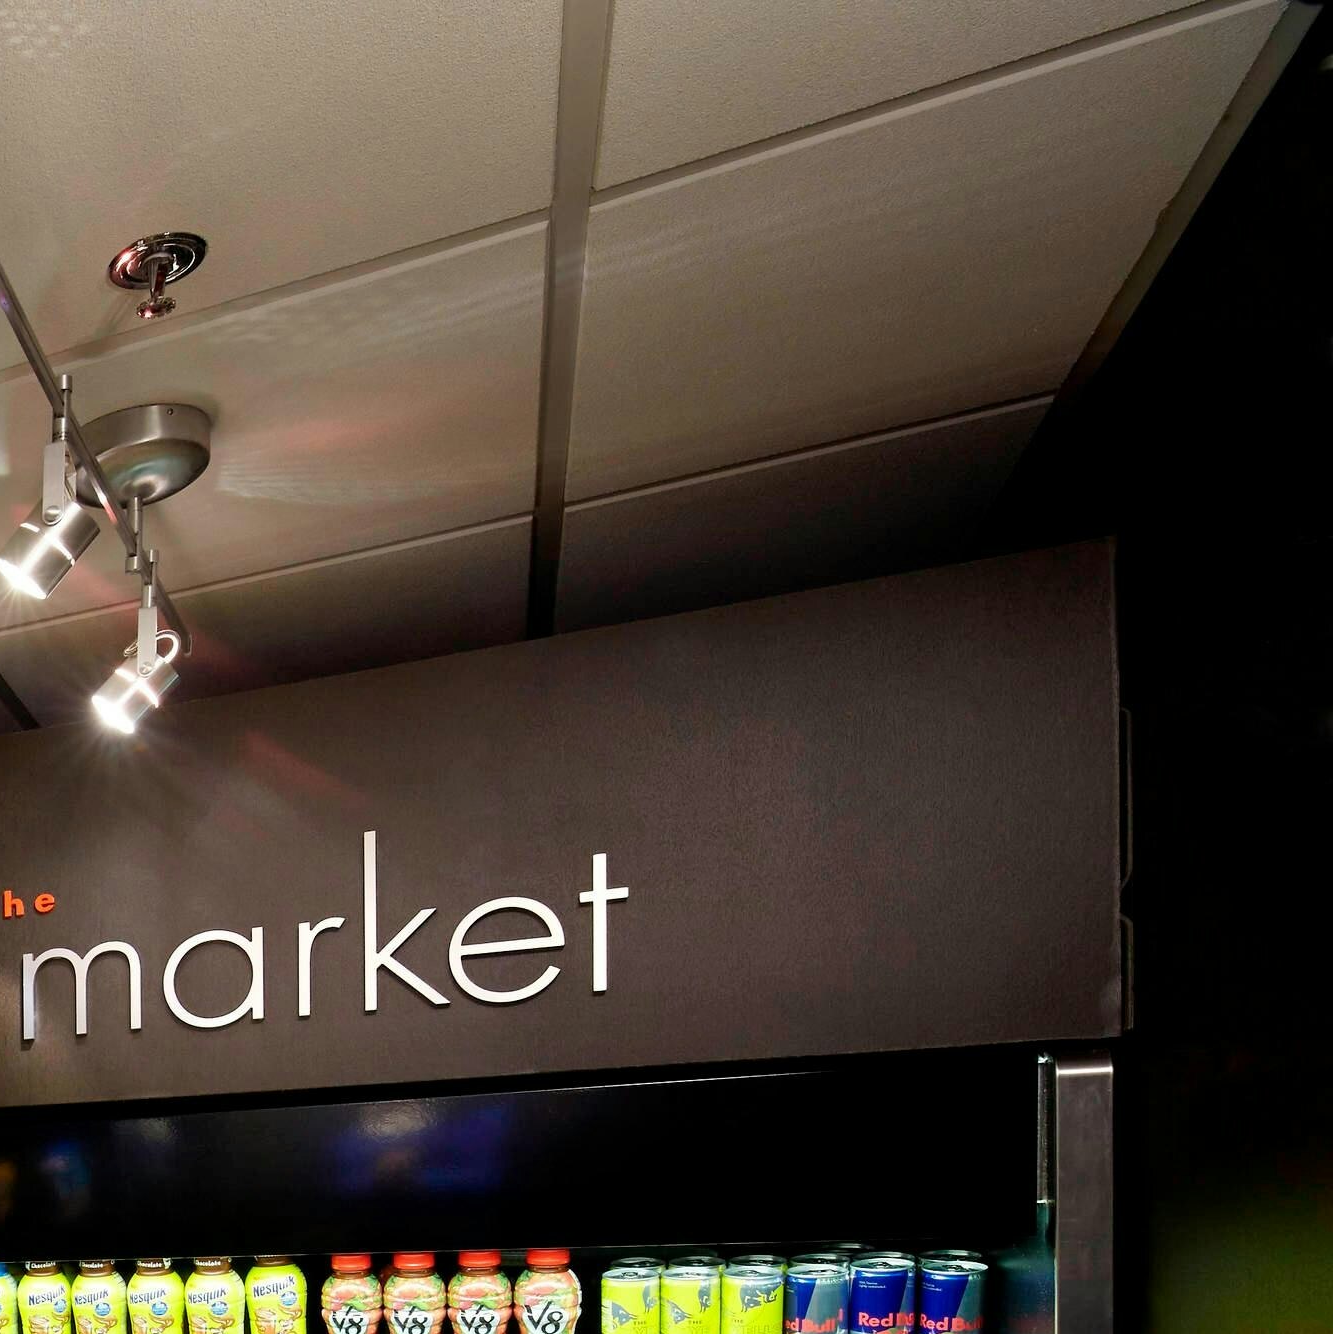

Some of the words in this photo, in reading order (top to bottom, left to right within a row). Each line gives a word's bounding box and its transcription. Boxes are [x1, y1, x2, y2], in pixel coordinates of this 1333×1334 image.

[20, 829, 630, 1041] market
[27, 1284, 67, 1307] Nesquik
[129, 1286, 168, 1306] Nesquik
[187, 1286, 228, 1306] Nesquik
[252, 1275, 296, 1298] Nesquik
[73, 1287, 110, 1307] Nesquik
[858, 1311, 894, 1328] Red
[920, 1313, 948, 1332] Red
